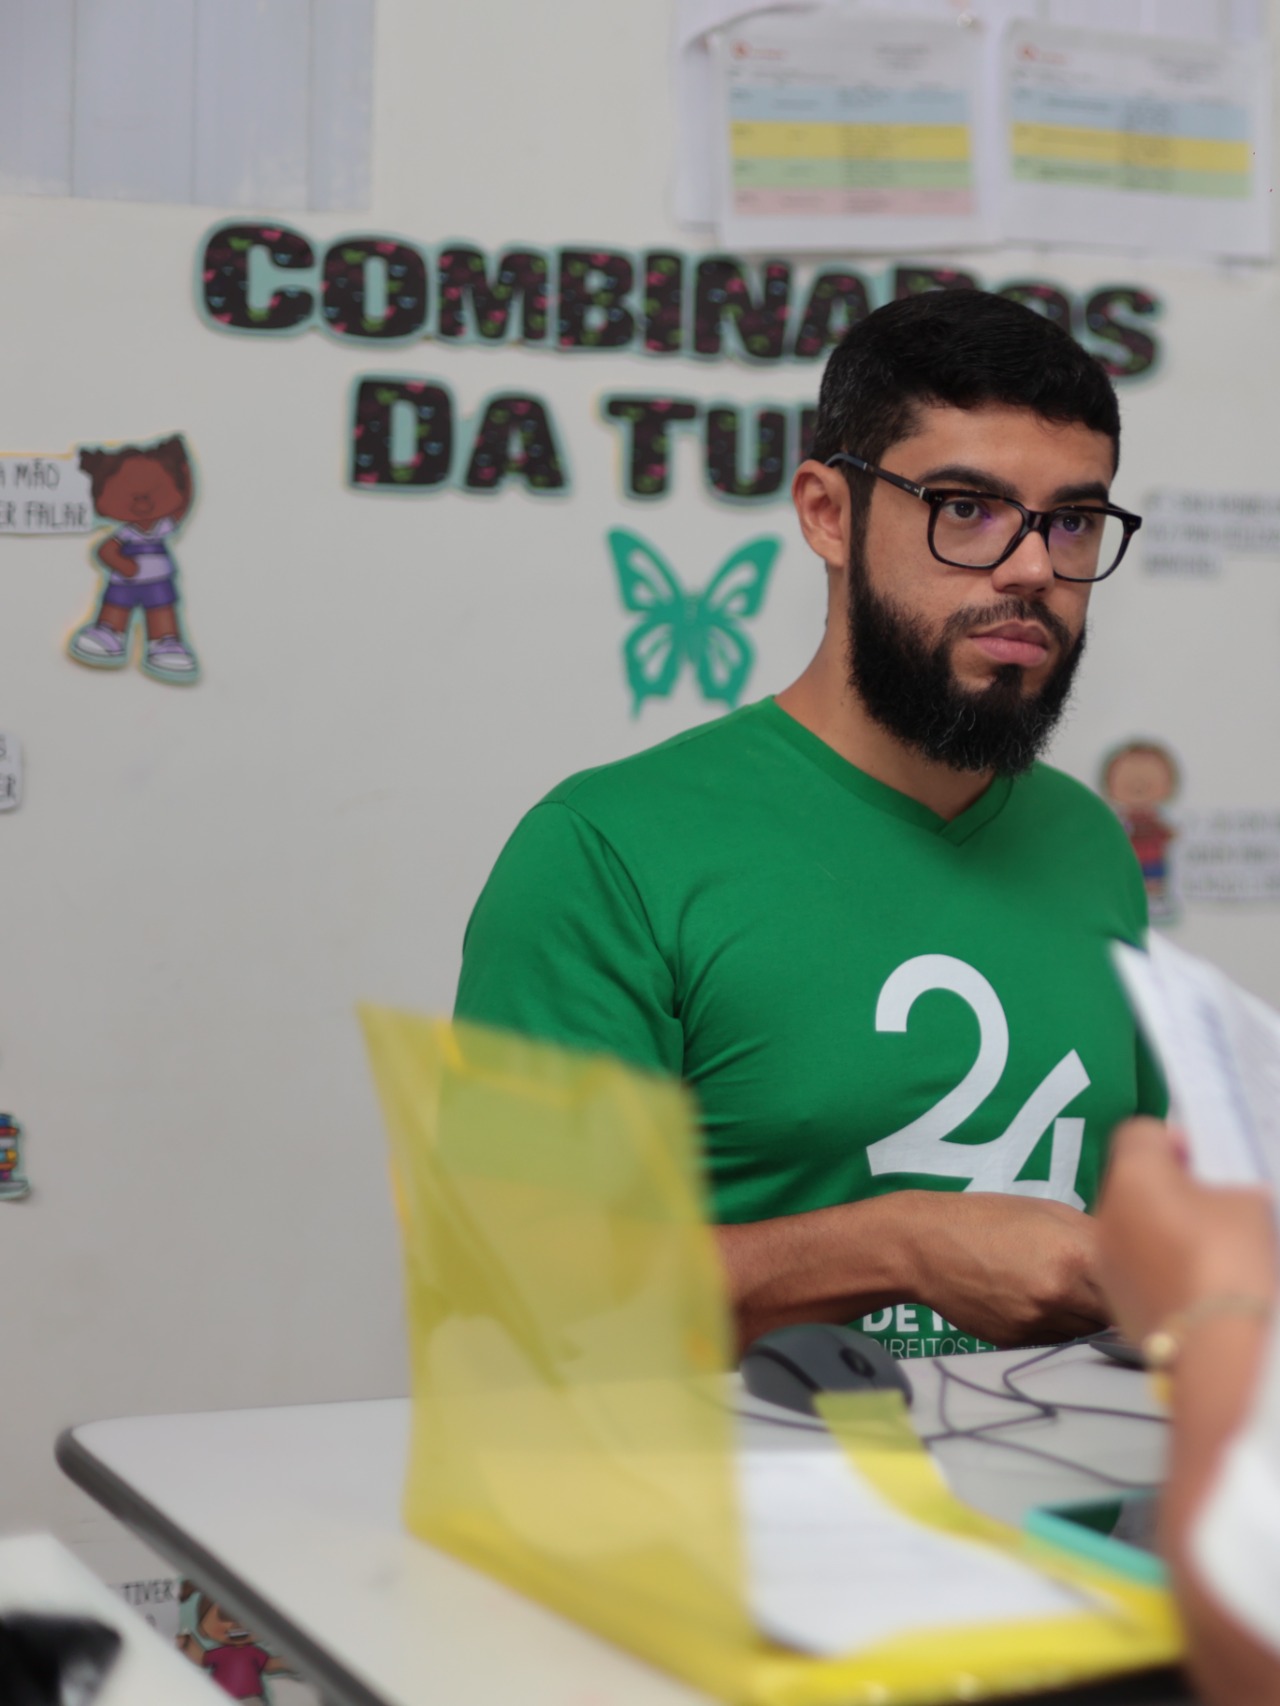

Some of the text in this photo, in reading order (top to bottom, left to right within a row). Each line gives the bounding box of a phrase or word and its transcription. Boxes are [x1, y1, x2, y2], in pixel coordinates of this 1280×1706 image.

[200, 220, 1160, 379] COMBINAS
[14, 457, 60, 491] MÃO
[350, 377, 819, 500] DA TU
[25, 501, 88, 528] FALAR
[866, 953, 1092, 1213] 24
